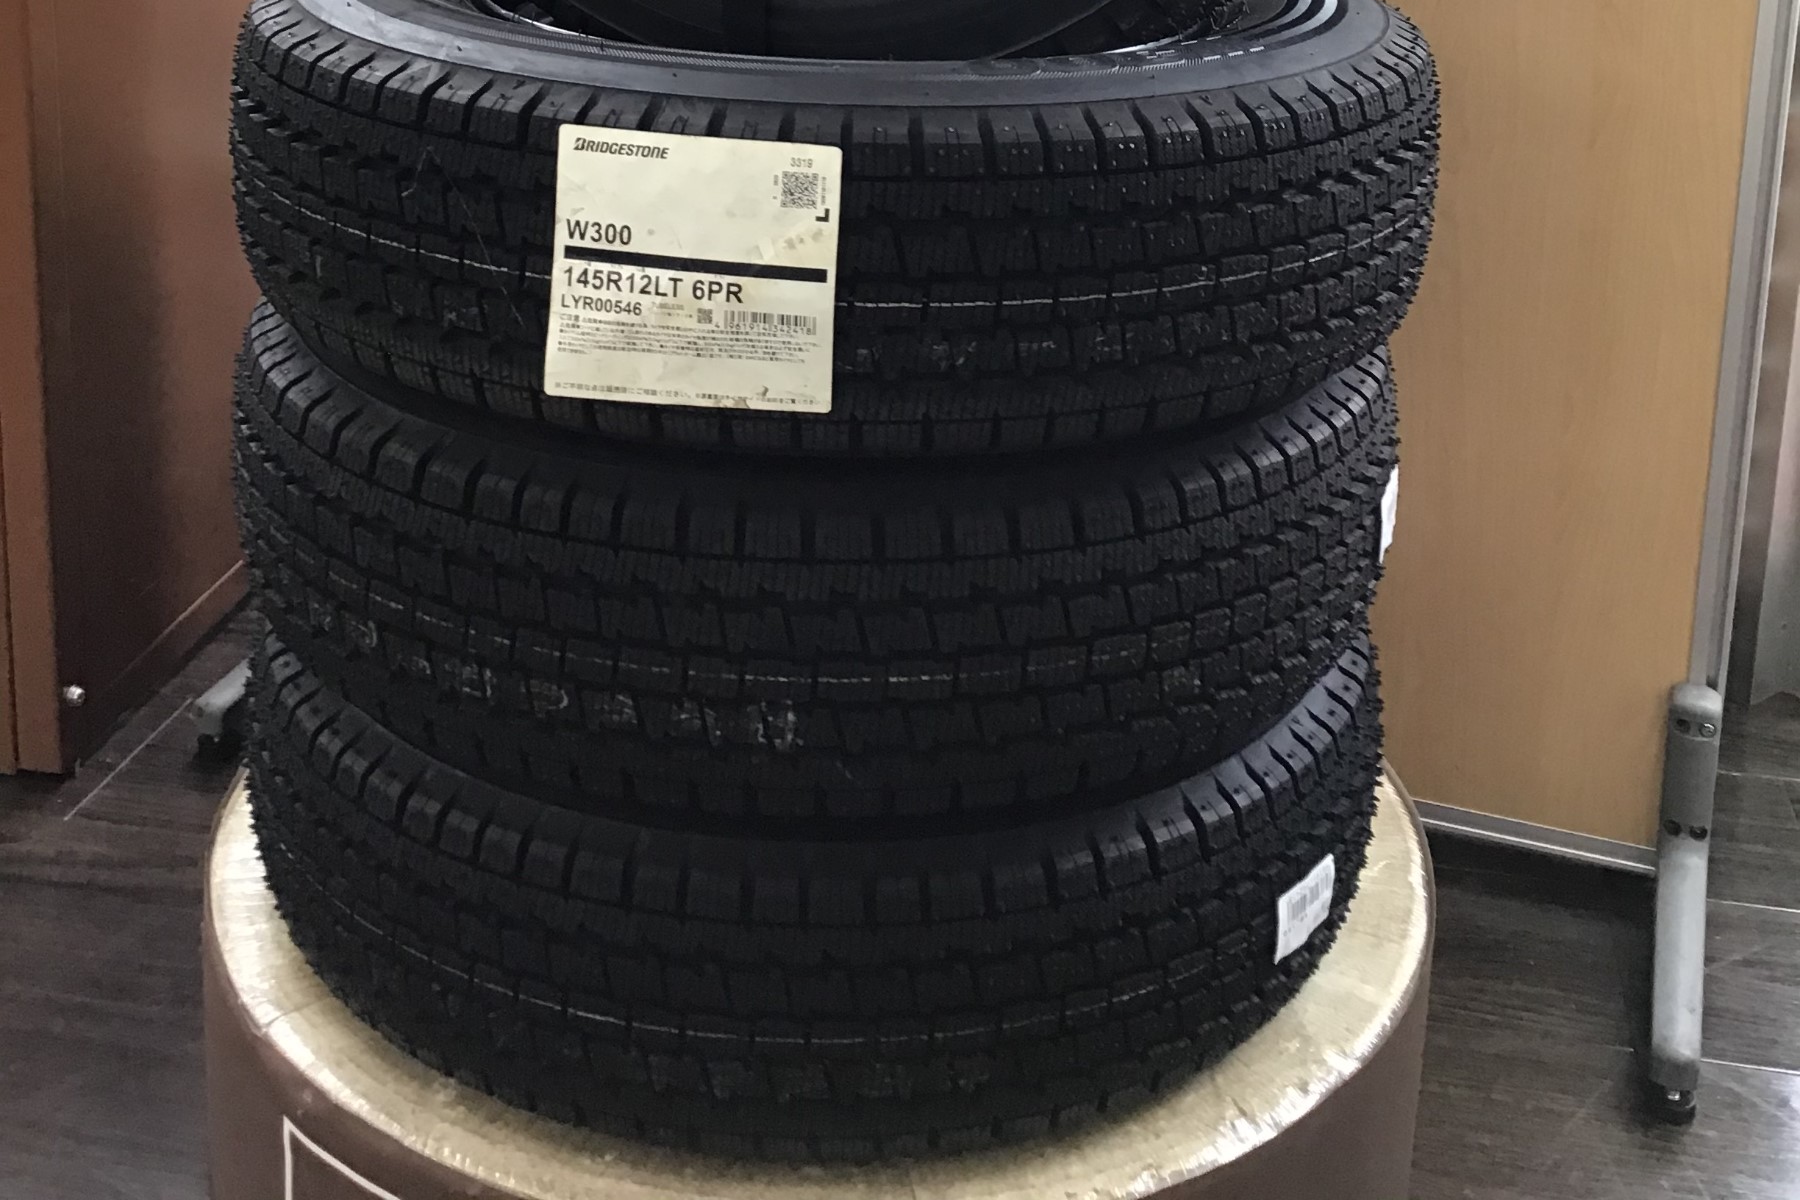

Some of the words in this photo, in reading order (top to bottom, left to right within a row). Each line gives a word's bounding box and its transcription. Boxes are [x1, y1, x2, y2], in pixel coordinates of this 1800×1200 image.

[573, 137, 670, 160] BRIDGESTONE
[565, 218, 633, 246] W300
[563, 265, 684, 299] 145R12LT
[691, 279, 745, 304] 6PR
[560, 293, 643, 317] LYR00546
